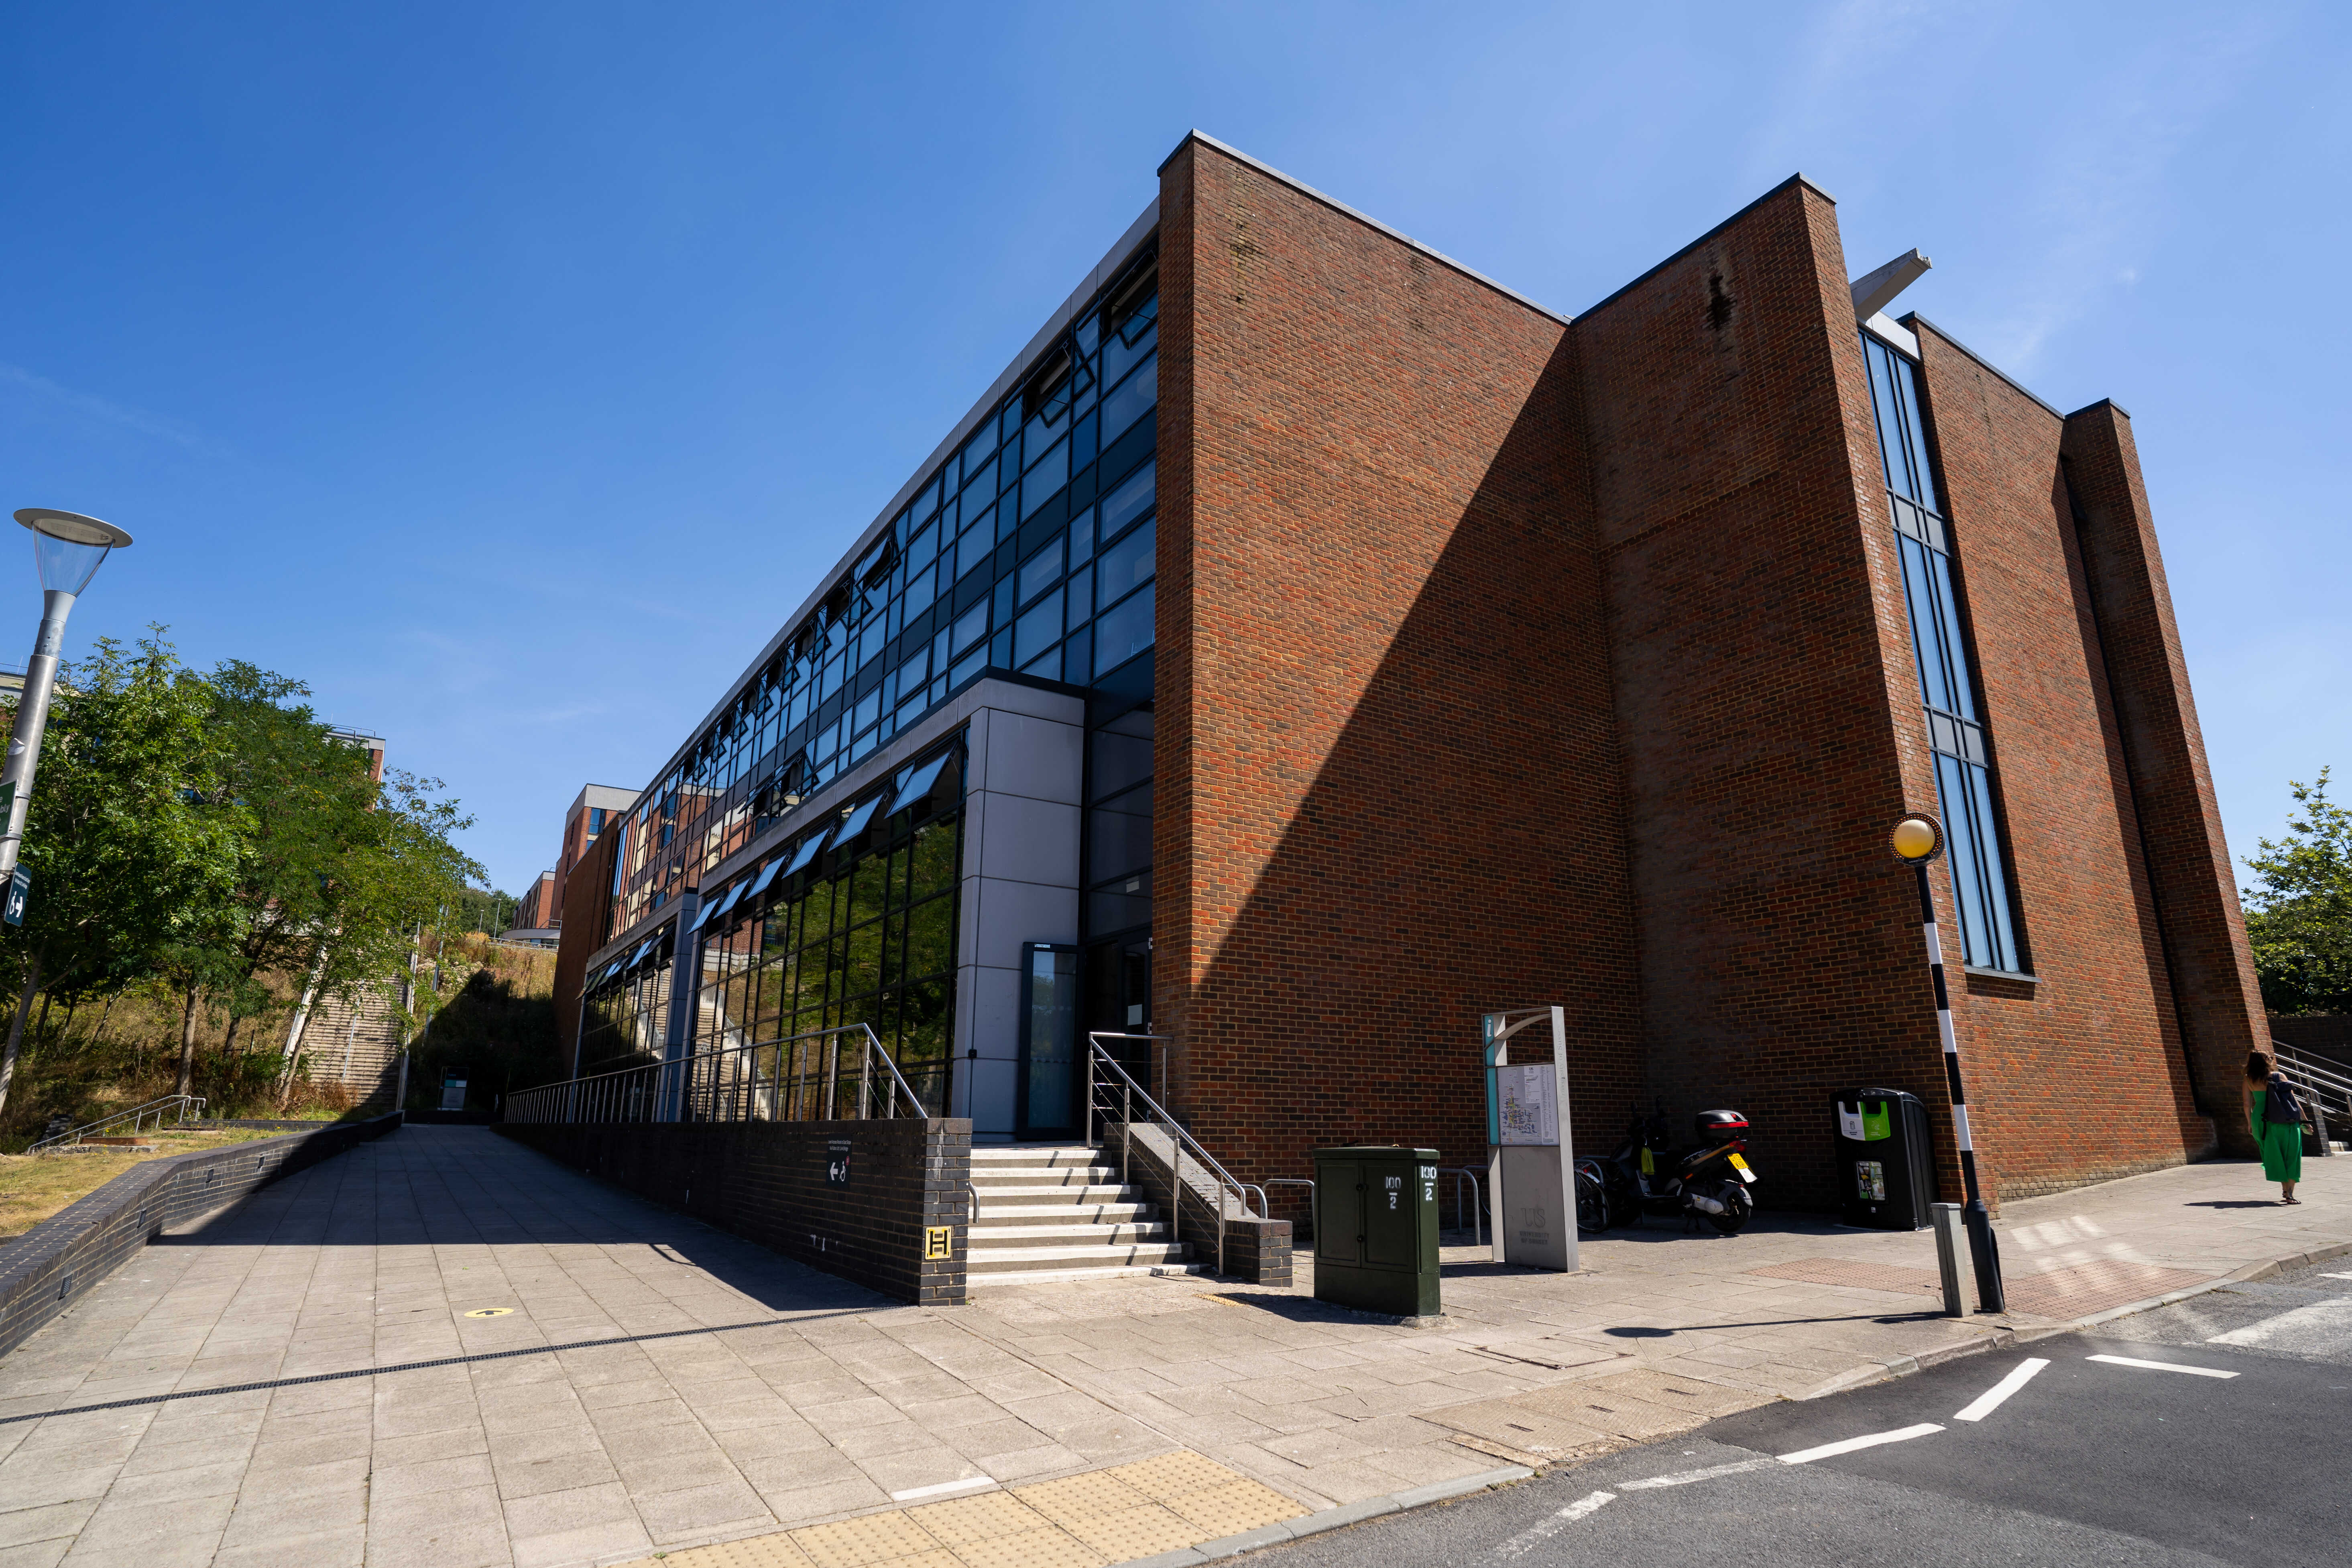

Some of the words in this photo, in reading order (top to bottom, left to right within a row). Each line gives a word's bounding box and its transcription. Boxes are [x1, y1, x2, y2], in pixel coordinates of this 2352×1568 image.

[1421, 1165, 1437, 1179] 100
[1386, 1176, 1401, 1189] 100
[1425, 1188, 1432, 1201] 2
[1390, 1196, 1396, 1209] 2
[929, 1230, 948, 1255] H
